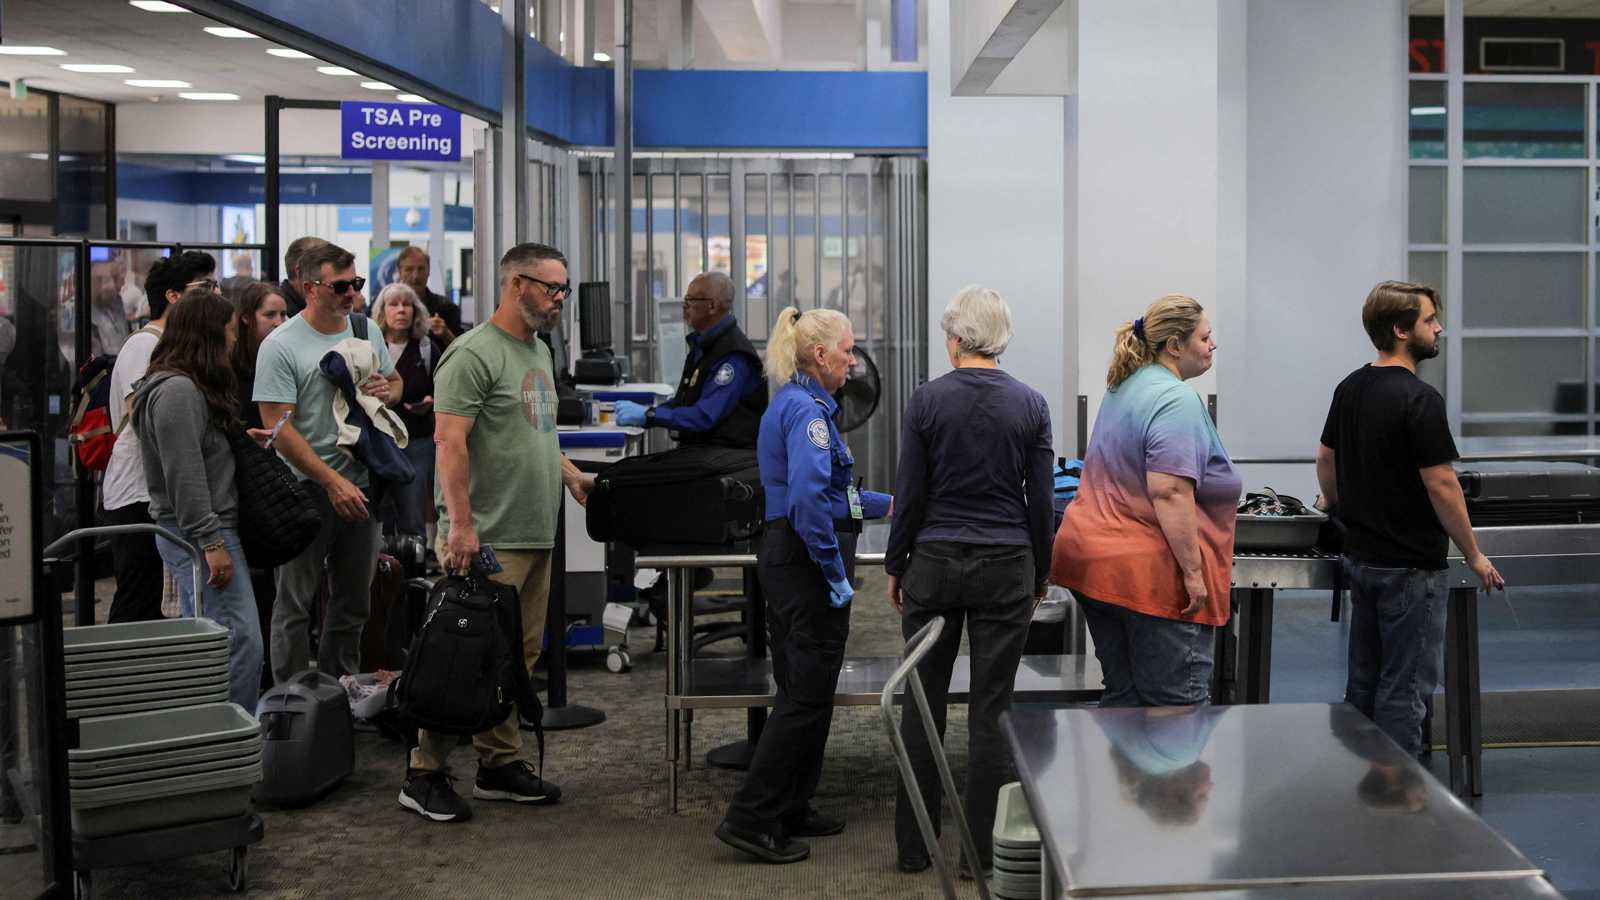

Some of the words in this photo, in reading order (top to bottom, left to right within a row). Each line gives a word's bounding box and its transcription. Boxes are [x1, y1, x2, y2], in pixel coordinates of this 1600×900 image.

[361, 107, 404, 126] TSA
[409, 109, 442, 127] Pre
[351, 131, 452, 155] Screening
